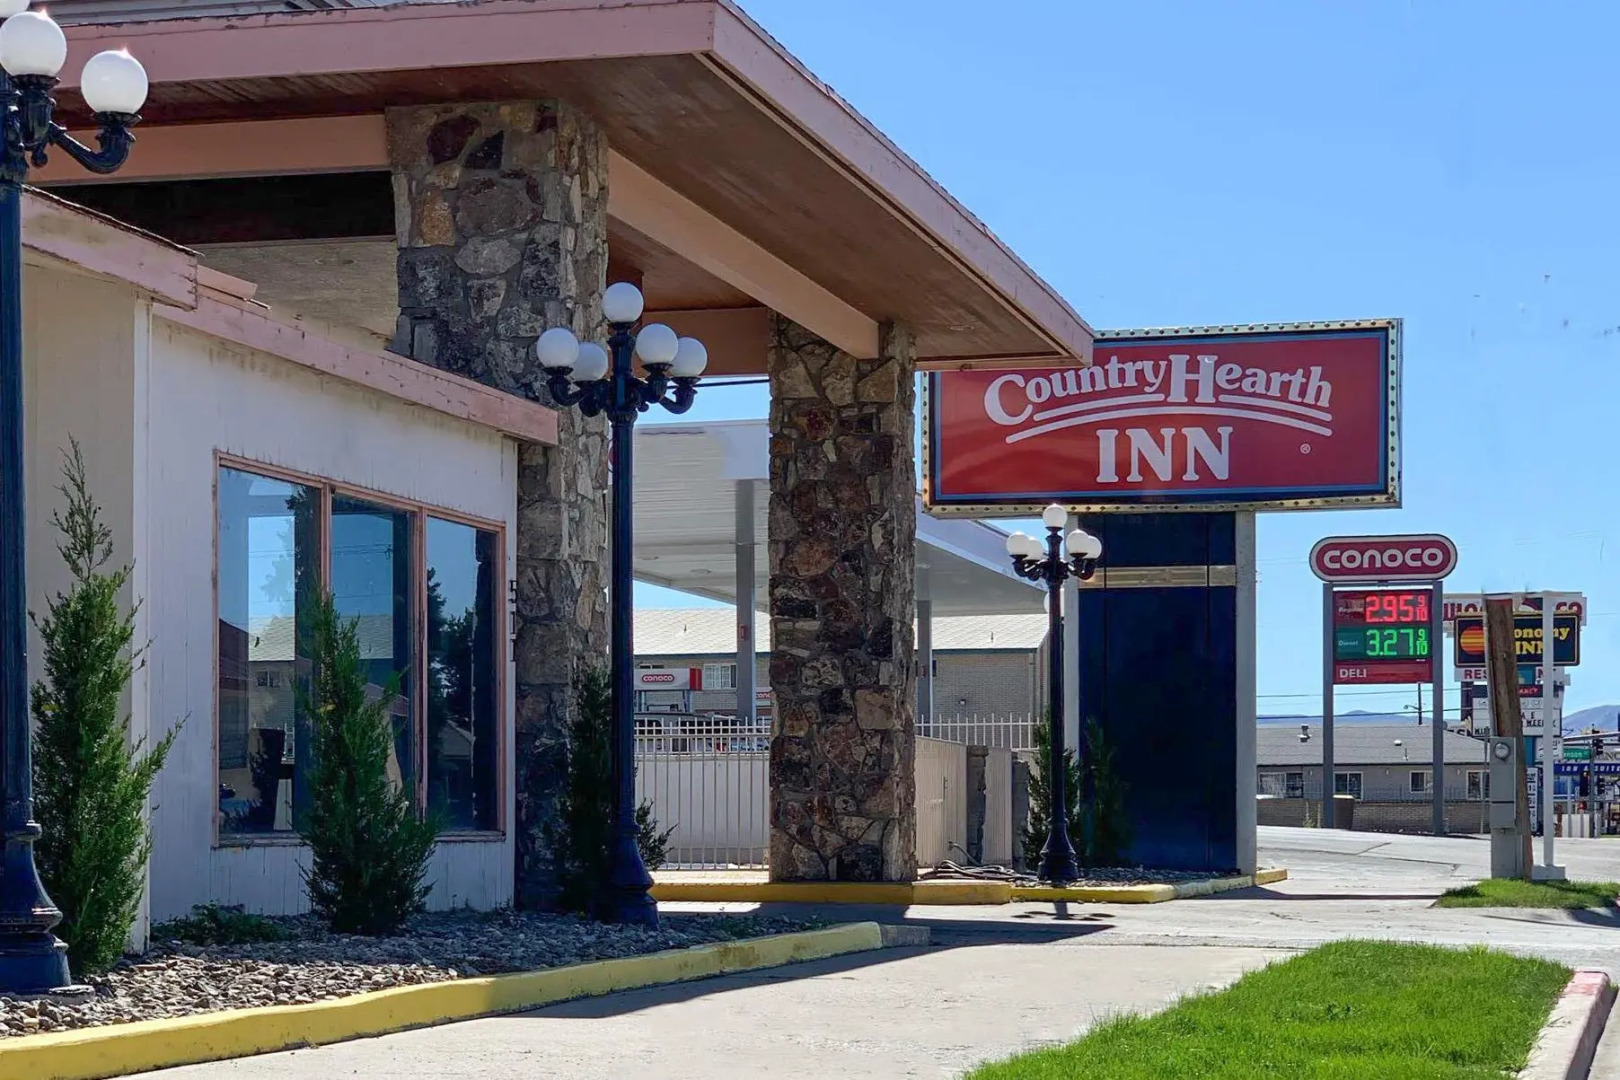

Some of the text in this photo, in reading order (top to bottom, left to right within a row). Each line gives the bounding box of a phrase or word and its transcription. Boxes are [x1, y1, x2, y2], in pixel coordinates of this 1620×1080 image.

[984, 353, 1332, 425] Country Hearth
[1096, 426, 1233, 483] INN
[1339, 668, 1367, 678] DELI
